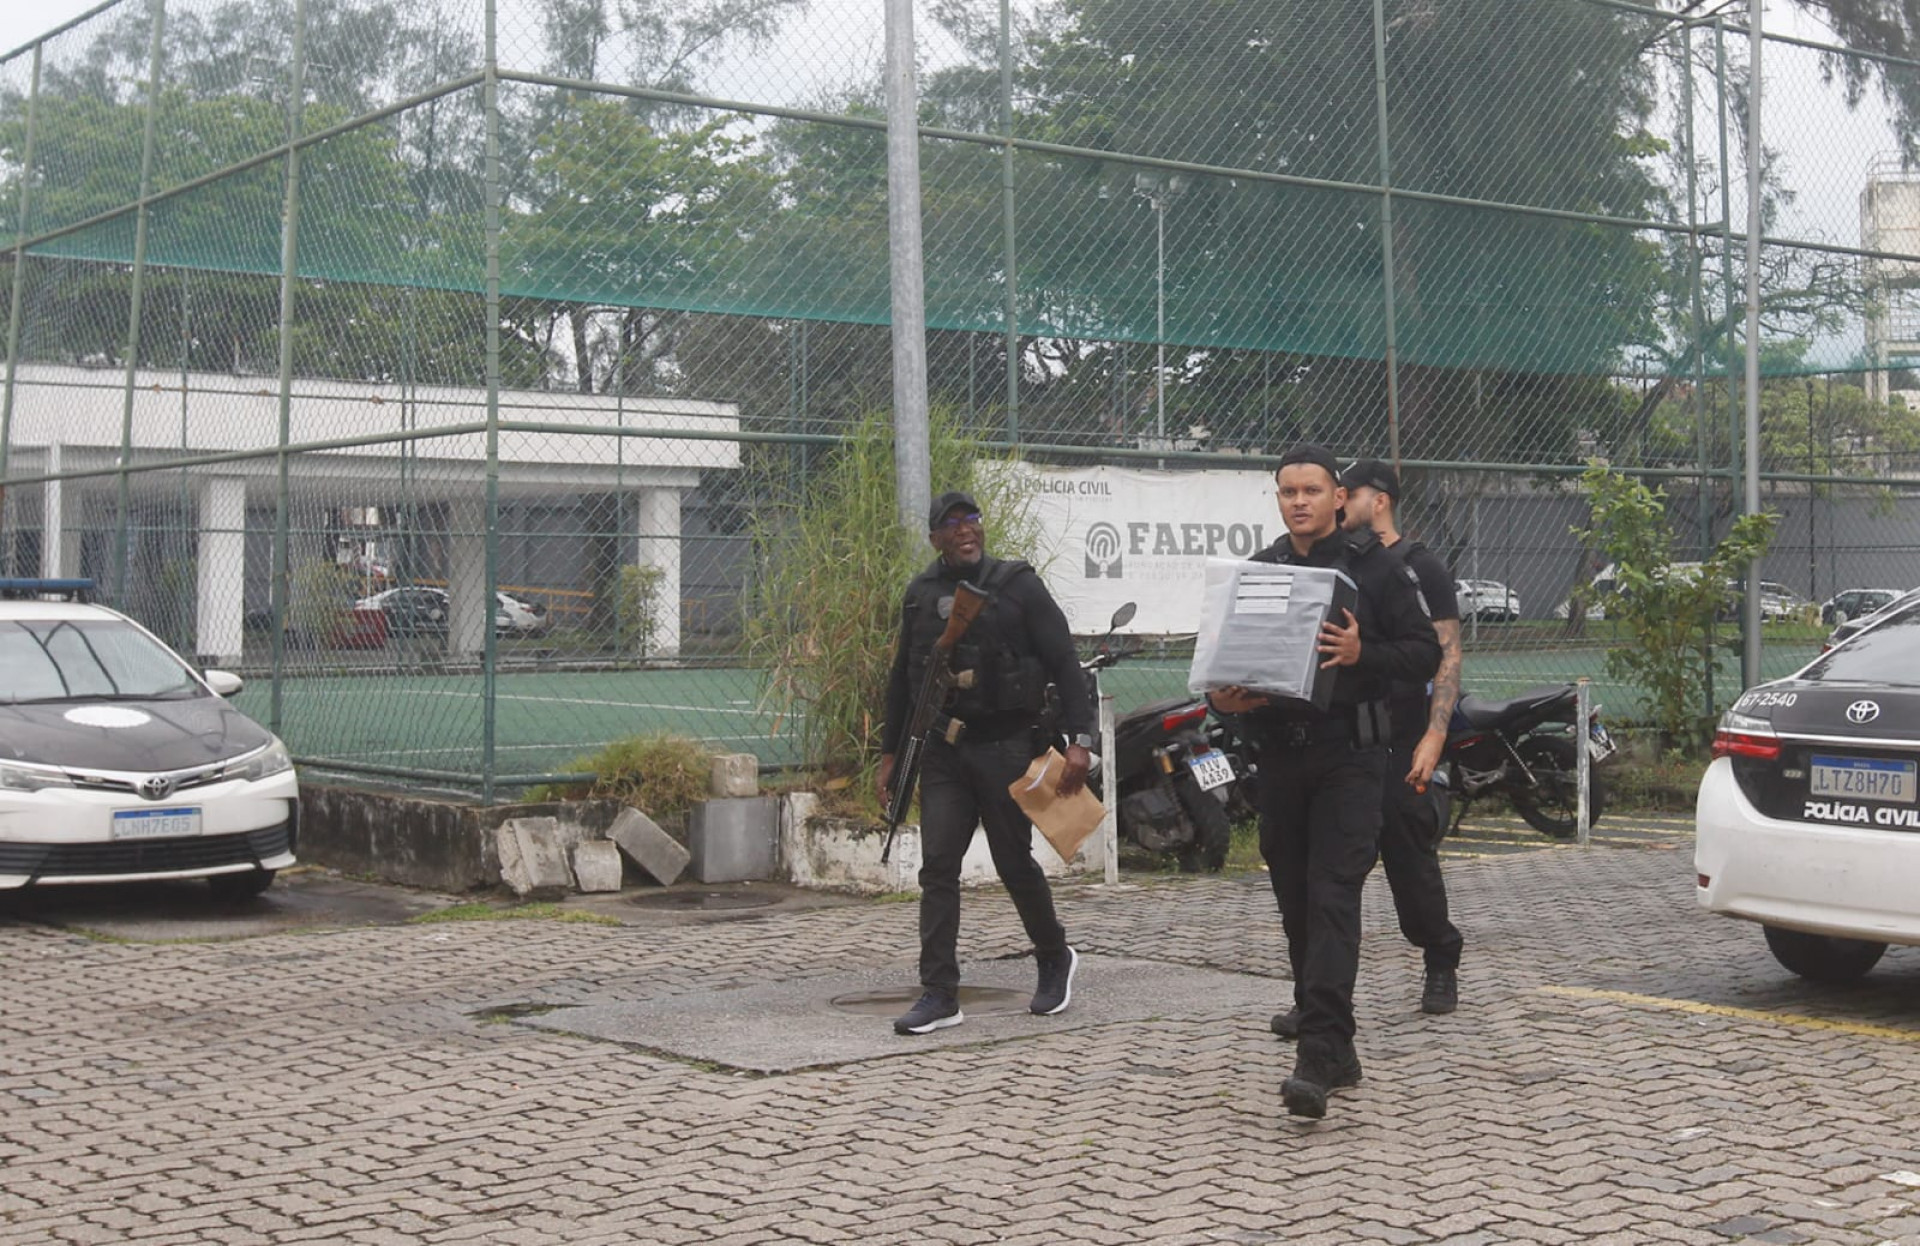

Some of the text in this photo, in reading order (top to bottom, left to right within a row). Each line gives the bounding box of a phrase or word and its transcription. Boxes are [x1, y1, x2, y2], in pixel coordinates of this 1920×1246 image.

[1024, 477, 1112, 495] POLÍCIA CIVIL
[1127, 522, 1272, 556] FAEPOL
[1820, 768, 1902, 796] LTZ8H70
[1804, 801, 1920, 827] POLÍCIA CIVIL
